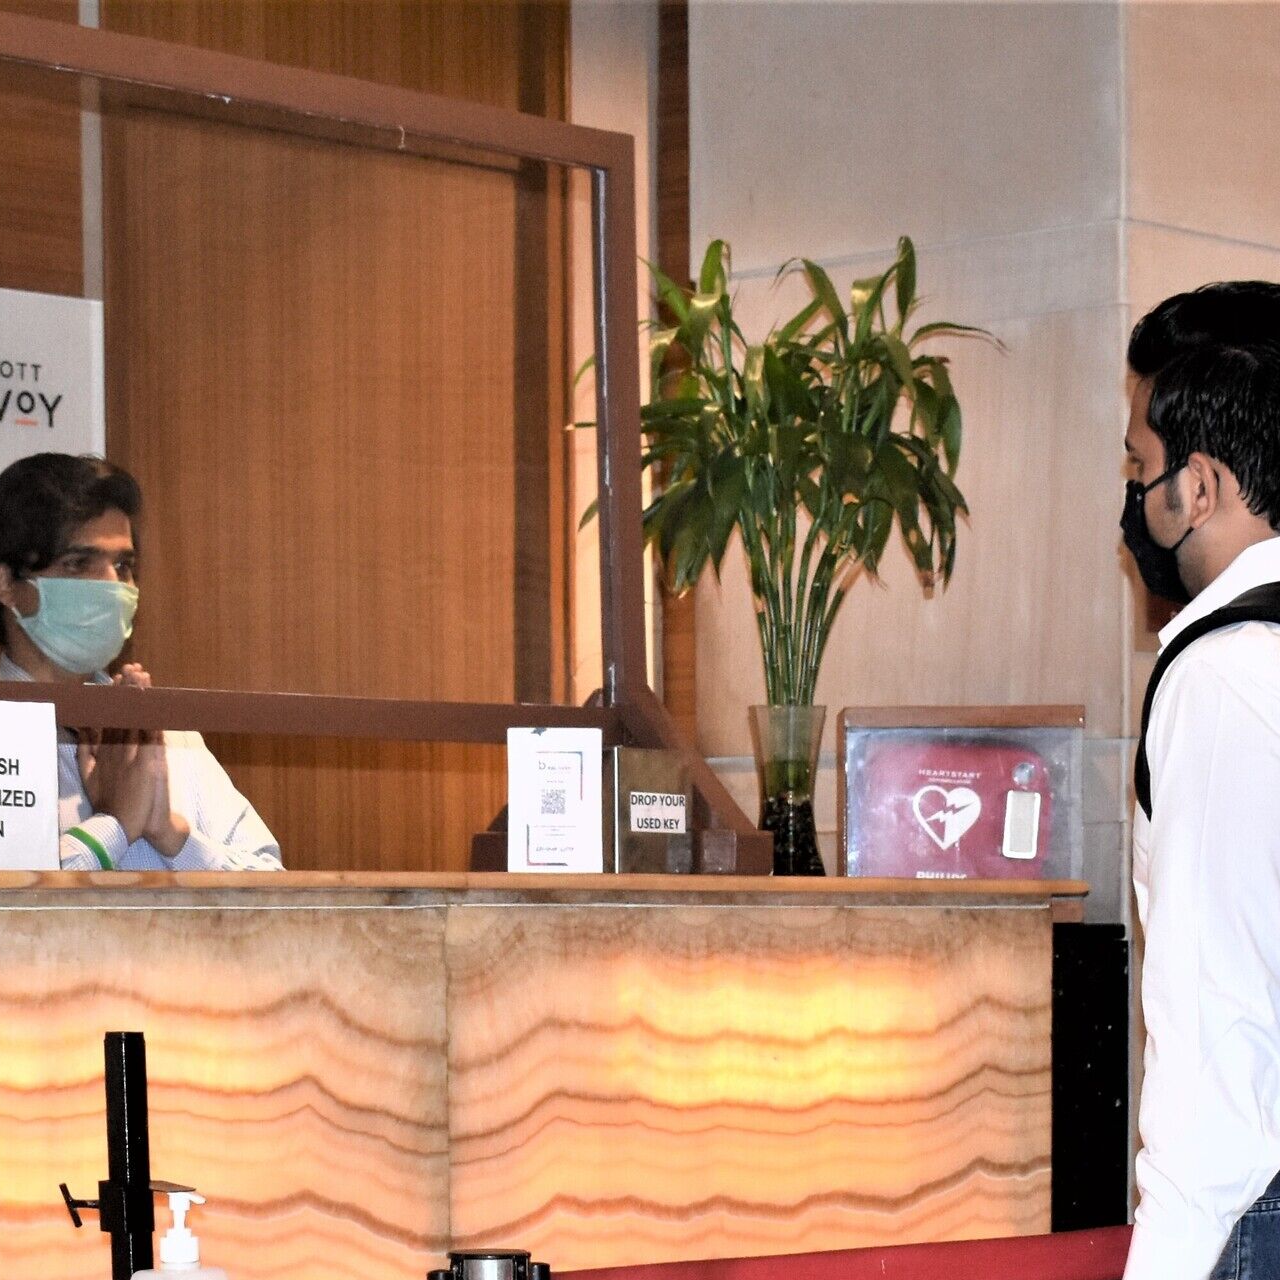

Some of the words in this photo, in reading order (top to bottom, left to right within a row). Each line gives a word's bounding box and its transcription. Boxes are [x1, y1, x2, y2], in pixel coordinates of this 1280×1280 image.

[631, 794, 658, 806] DROP
[659, 795, 685, 807] YOUR
[636, 818, 661, 829] USED
[663, 818, 680, 830] KEY
